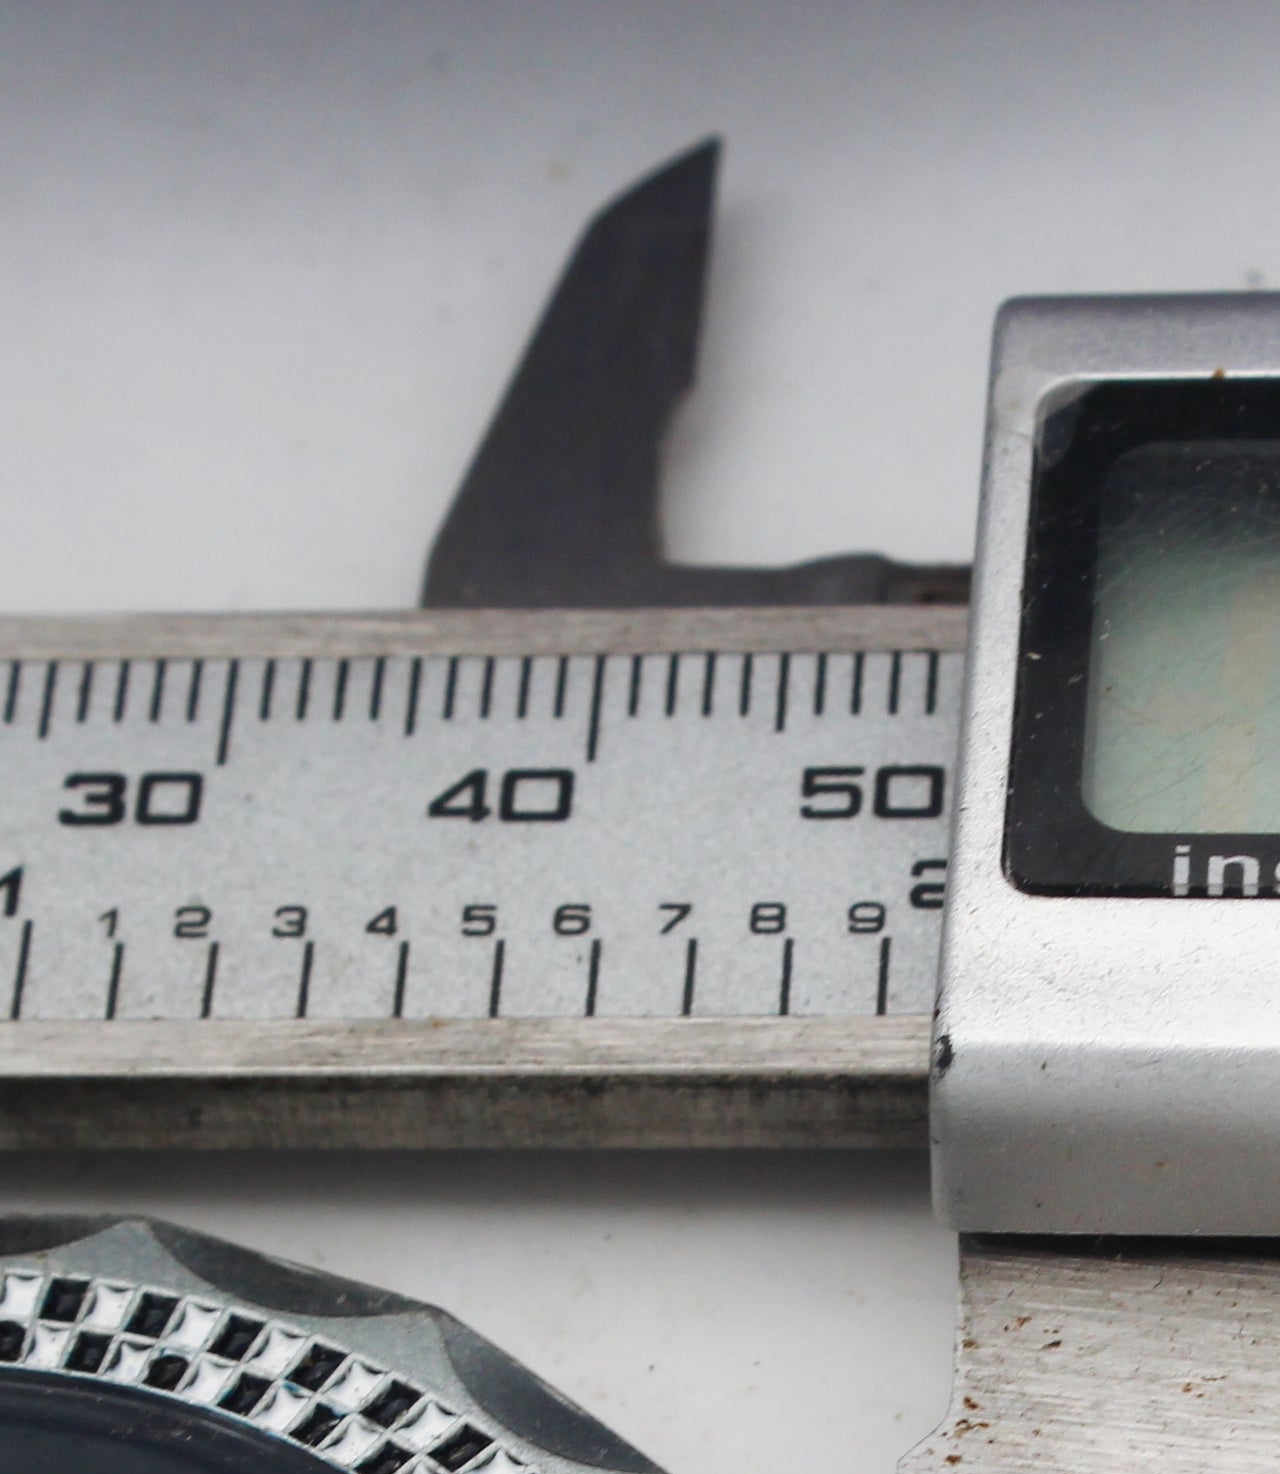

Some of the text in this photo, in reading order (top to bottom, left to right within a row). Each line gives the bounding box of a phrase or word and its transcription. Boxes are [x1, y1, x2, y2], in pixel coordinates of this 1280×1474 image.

[58, 771, 204, 828] 30
[427, 768, 576, 824] 40
[799, 764, 946, 821] 50
[99, 907, 120, 939] 1
[173, 905, 212, 939] 2
[272, 905, 308, 939] 3
[365, 905, 399, 938] 4
[461, 904, 497, 938] 5
[552, 904, 591, 938] 6
[658, 902, 693, 936] 7
[749, 902, 787, 935] 8
[848, 901, 886, 935] 9
